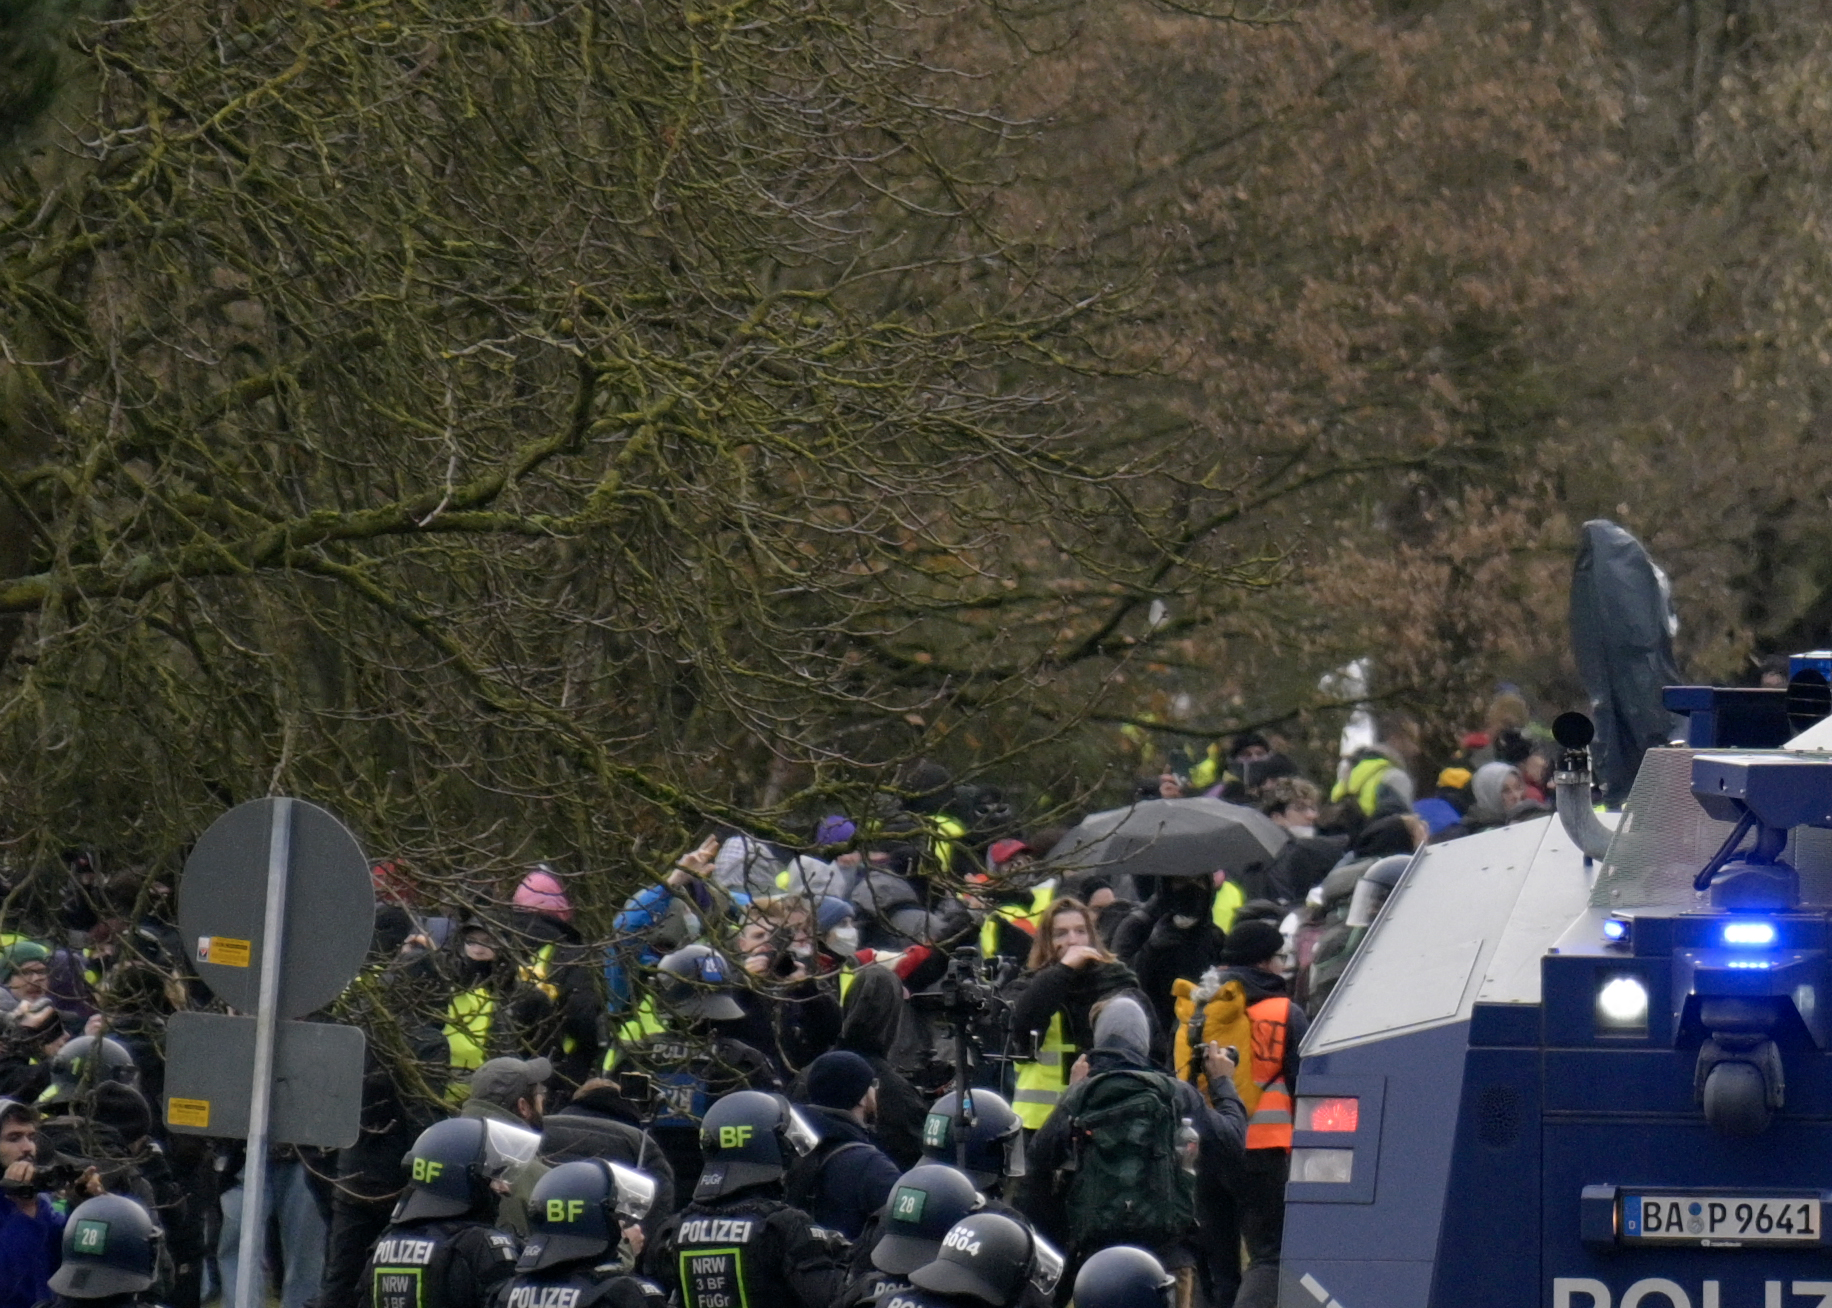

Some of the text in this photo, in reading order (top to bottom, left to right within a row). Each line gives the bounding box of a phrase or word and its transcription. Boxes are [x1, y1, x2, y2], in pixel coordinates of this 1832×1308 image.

[720, 1126, 753, 1148] BF
[928, 1119, 941, 1135] 28
[412, 1157, 443, 1183] BF
[547, 1200, 584, 1222] BF
[899, 1196, 915, 1213] 28
[1643, 1202, 1683, 1232] BA
[1708, 1203, 1727, 1233] P
[1735, 1203, 1814, 1234] 9641
[82, 1228, 98, 1246] 28
[678, 1220, 753, 1243] POLIZEI
[373, 1240, 435, 1265] POLIZEI
[693, 1257, 726, 1275] NRW
[382, 1276, 408, 1293] NRW
[707, 1277, 726, 1290] BF
